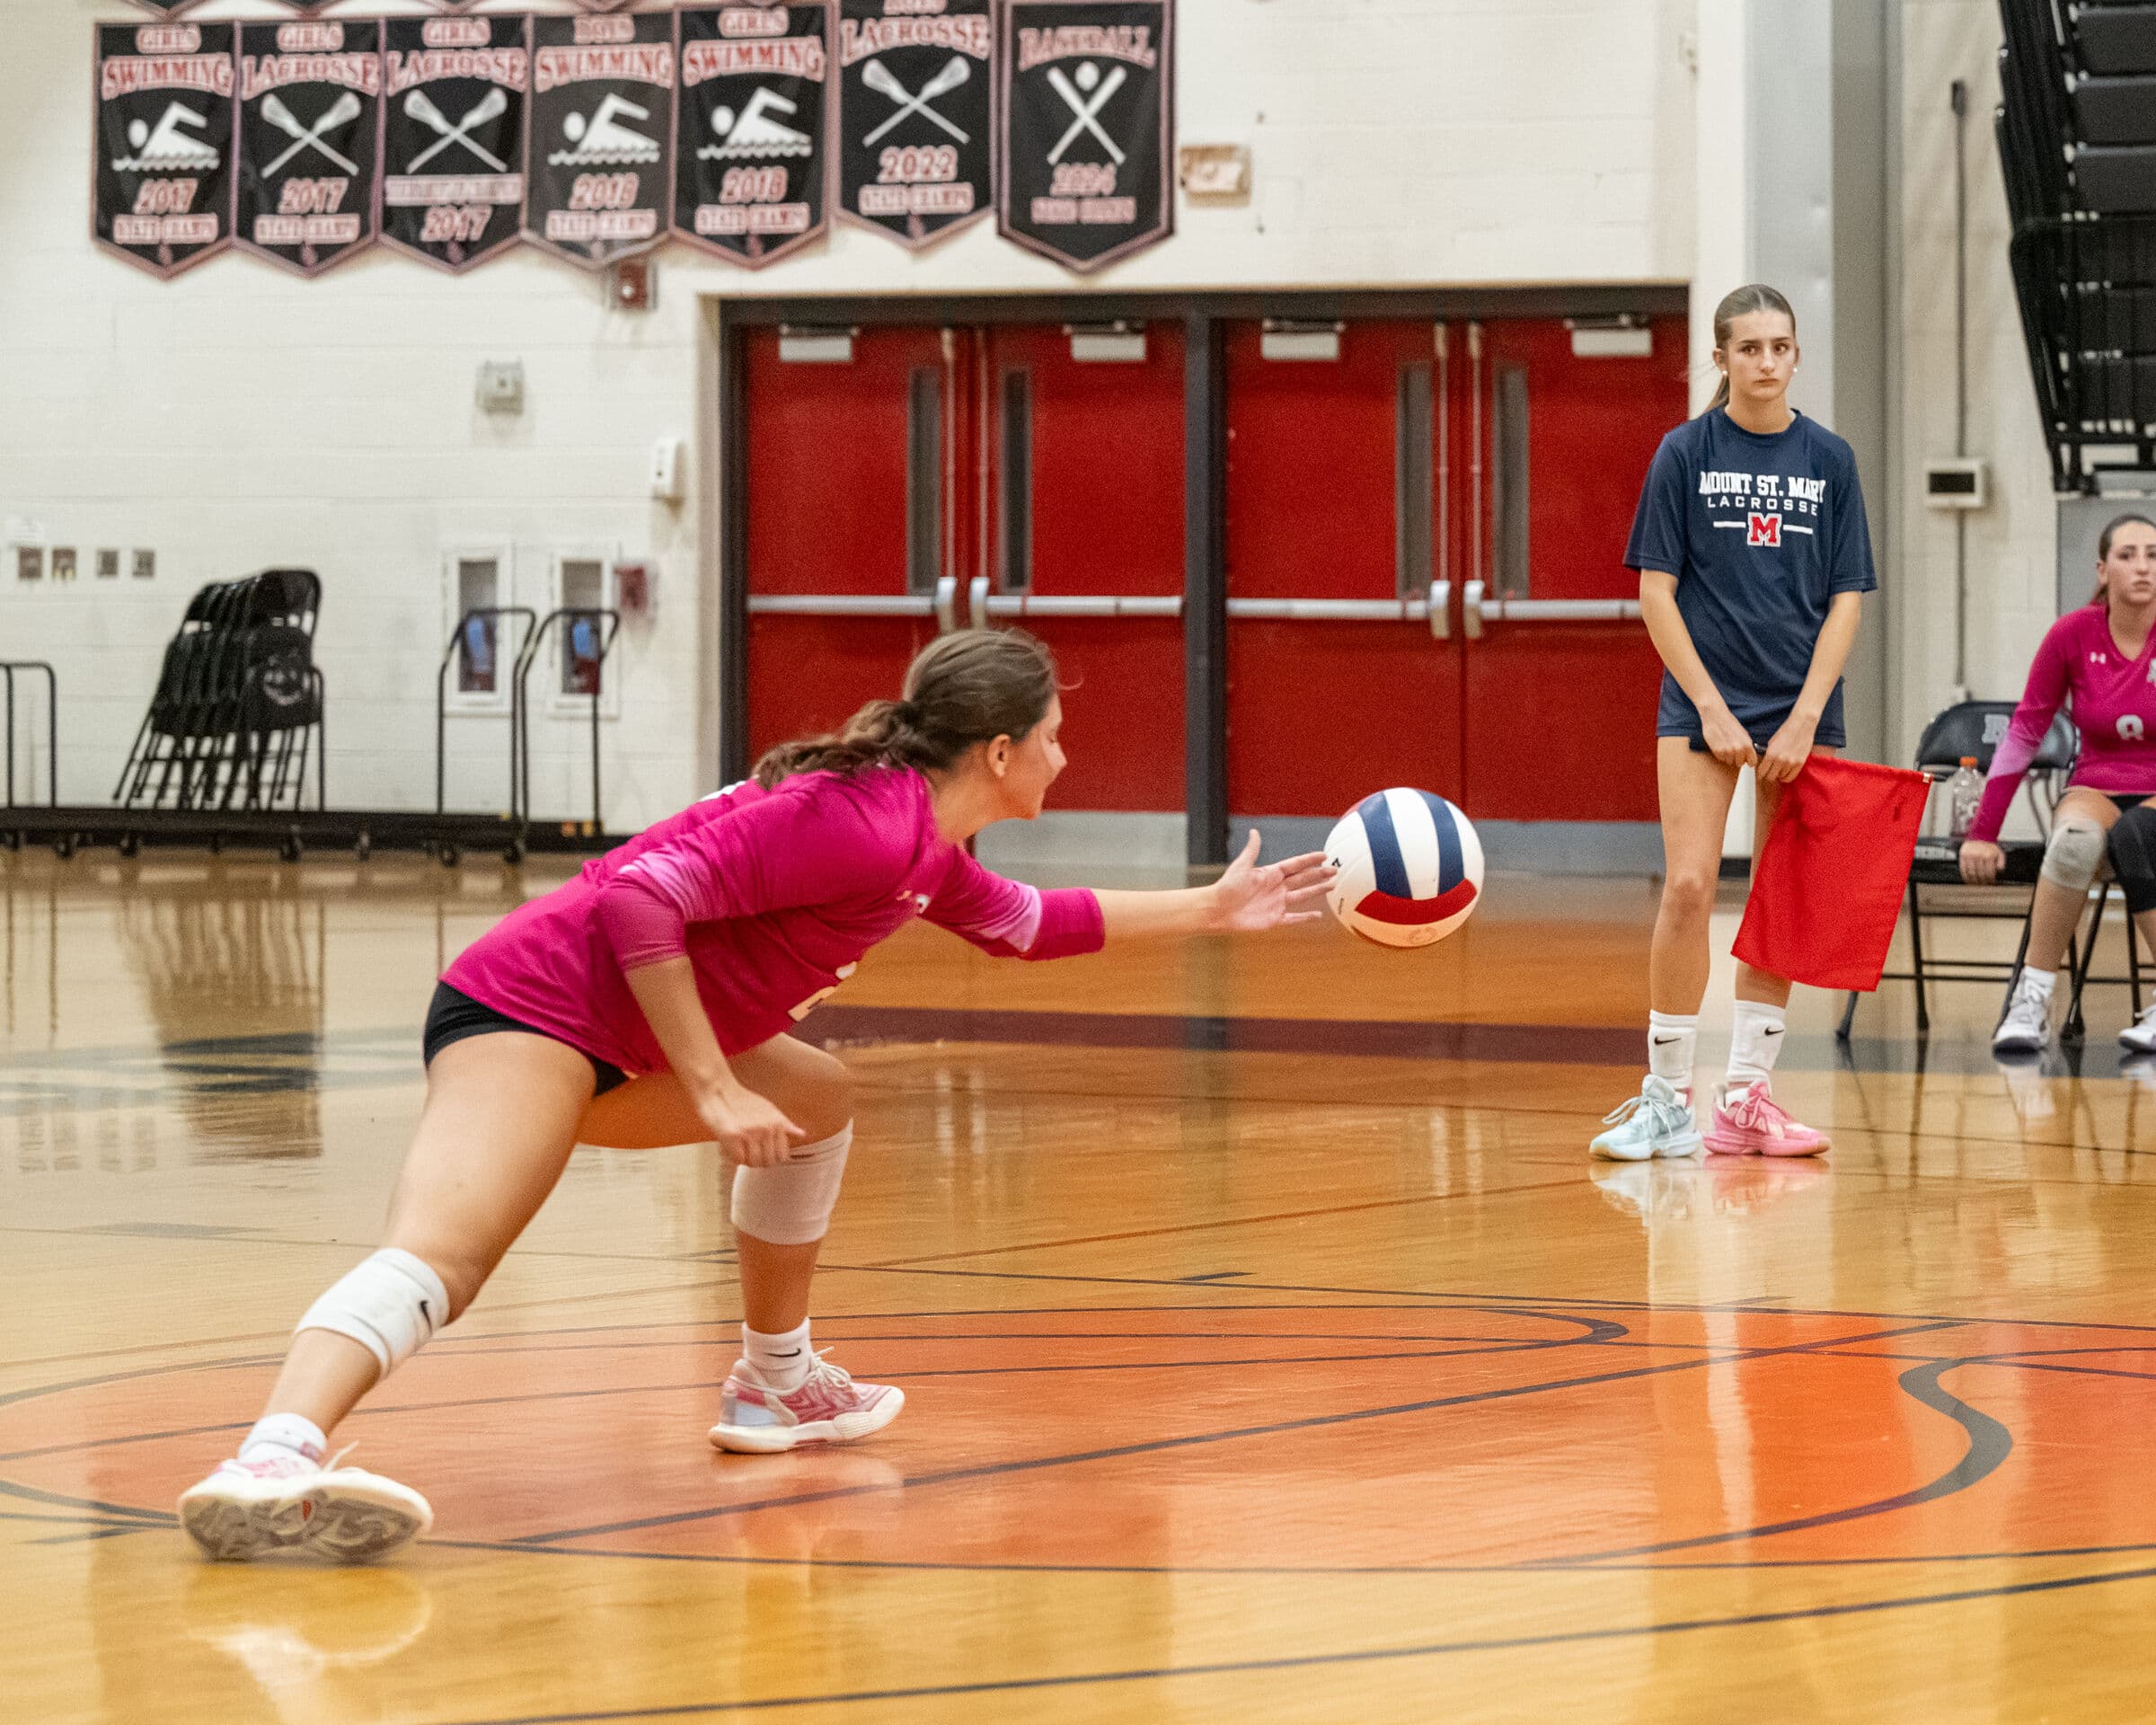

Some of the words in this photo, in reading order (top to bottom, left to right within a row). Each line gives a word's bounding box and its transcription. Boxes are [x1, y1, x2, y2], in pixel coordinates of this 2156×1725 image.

[683, 35, 826, 87] SWIMMING
[839, 13, 989, 67] LACROSSE
[101, 52, 234, 101] SWIMMING
[242, 52, 379, 101] LACROSSE
[386, 47, 528, 97] LACROSSE
[535, 42, 673, 93] SWIMMING
[877, 144, 959, 183] 2022
[277, 177, 349, 214] 2017
[419, 205, 493, 243] 2017
[1699, 471, 1752, 495] MOUNT
[1757, 474, 1784, 497] ST.
[1788, 476, 1826, 503] MARY
[1708, 495, 1818, 517] LACROSSE
[1747, 512, 1782, 547] M
